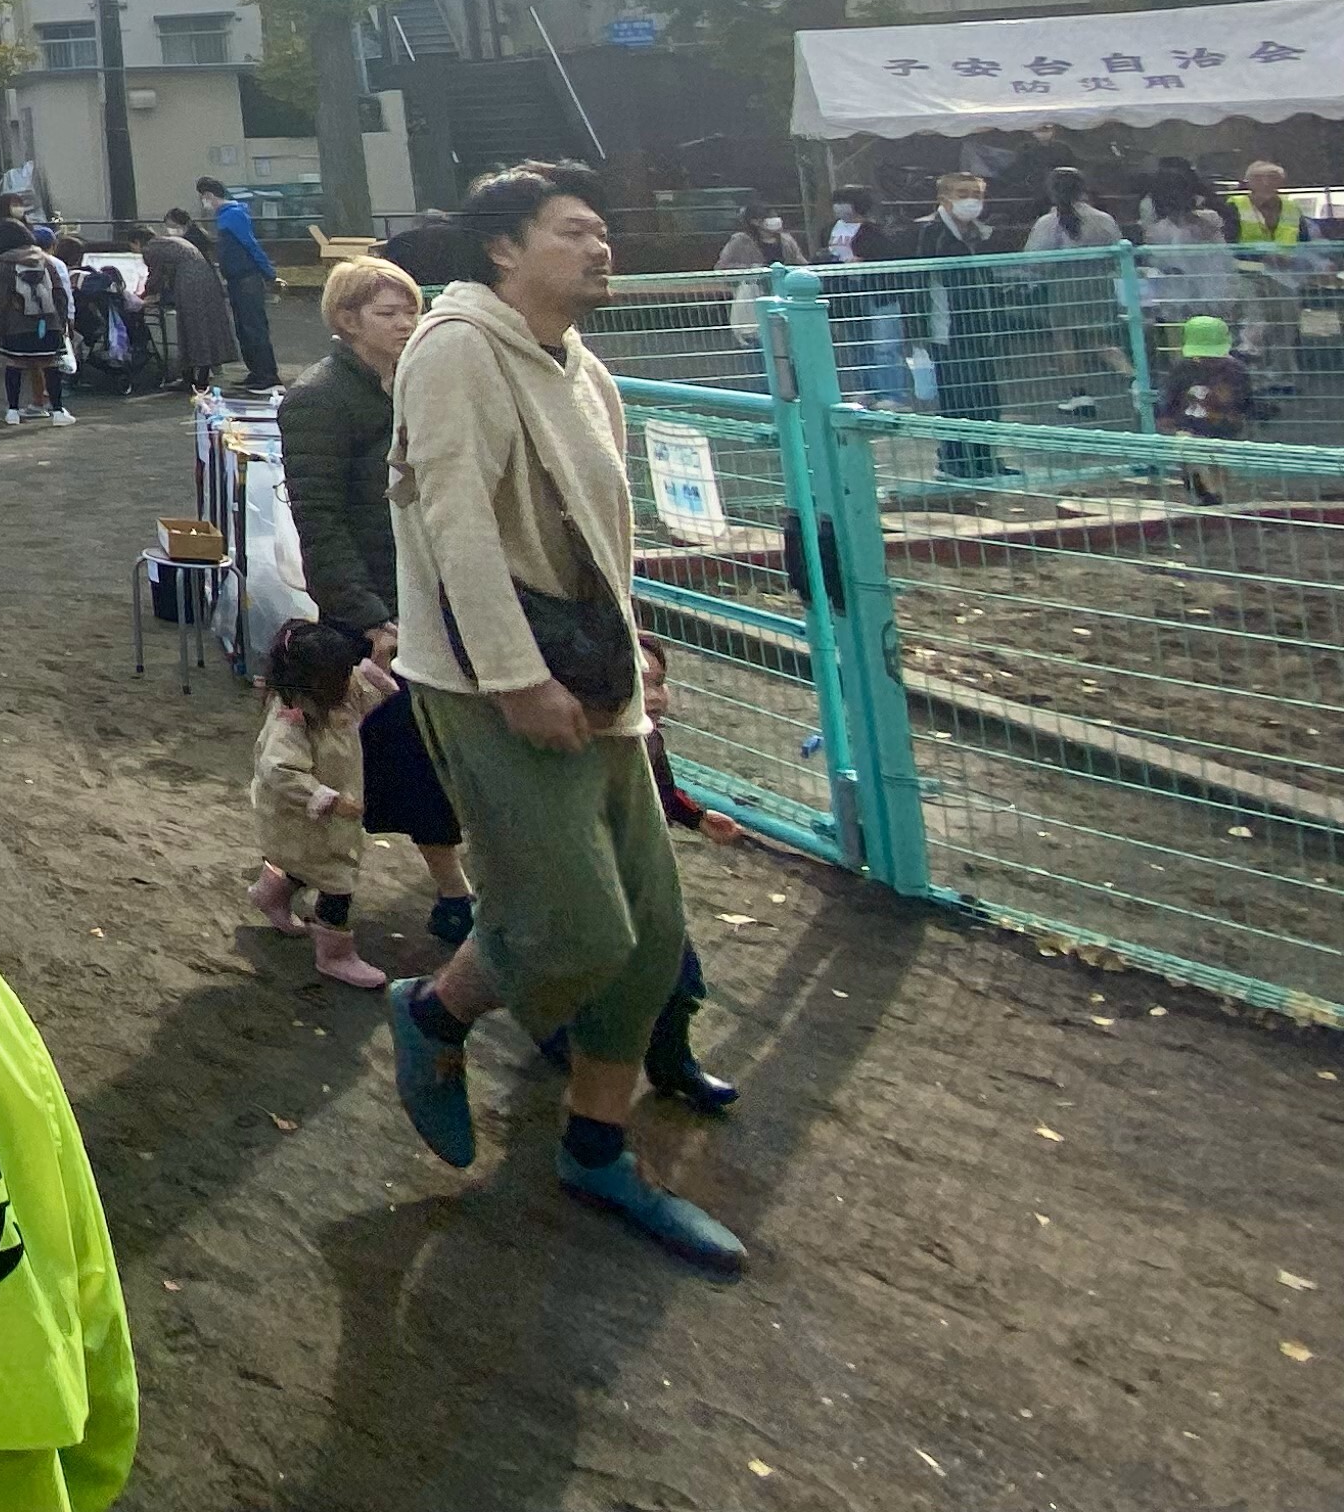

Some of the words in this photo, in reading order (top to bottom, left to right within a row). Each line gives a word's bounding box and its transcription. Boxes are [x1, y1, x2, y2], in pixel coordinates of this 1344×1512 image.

[882, 40, 1306, 78] 子安台自治会
[1010, 74, 1185, 94] 防災用
